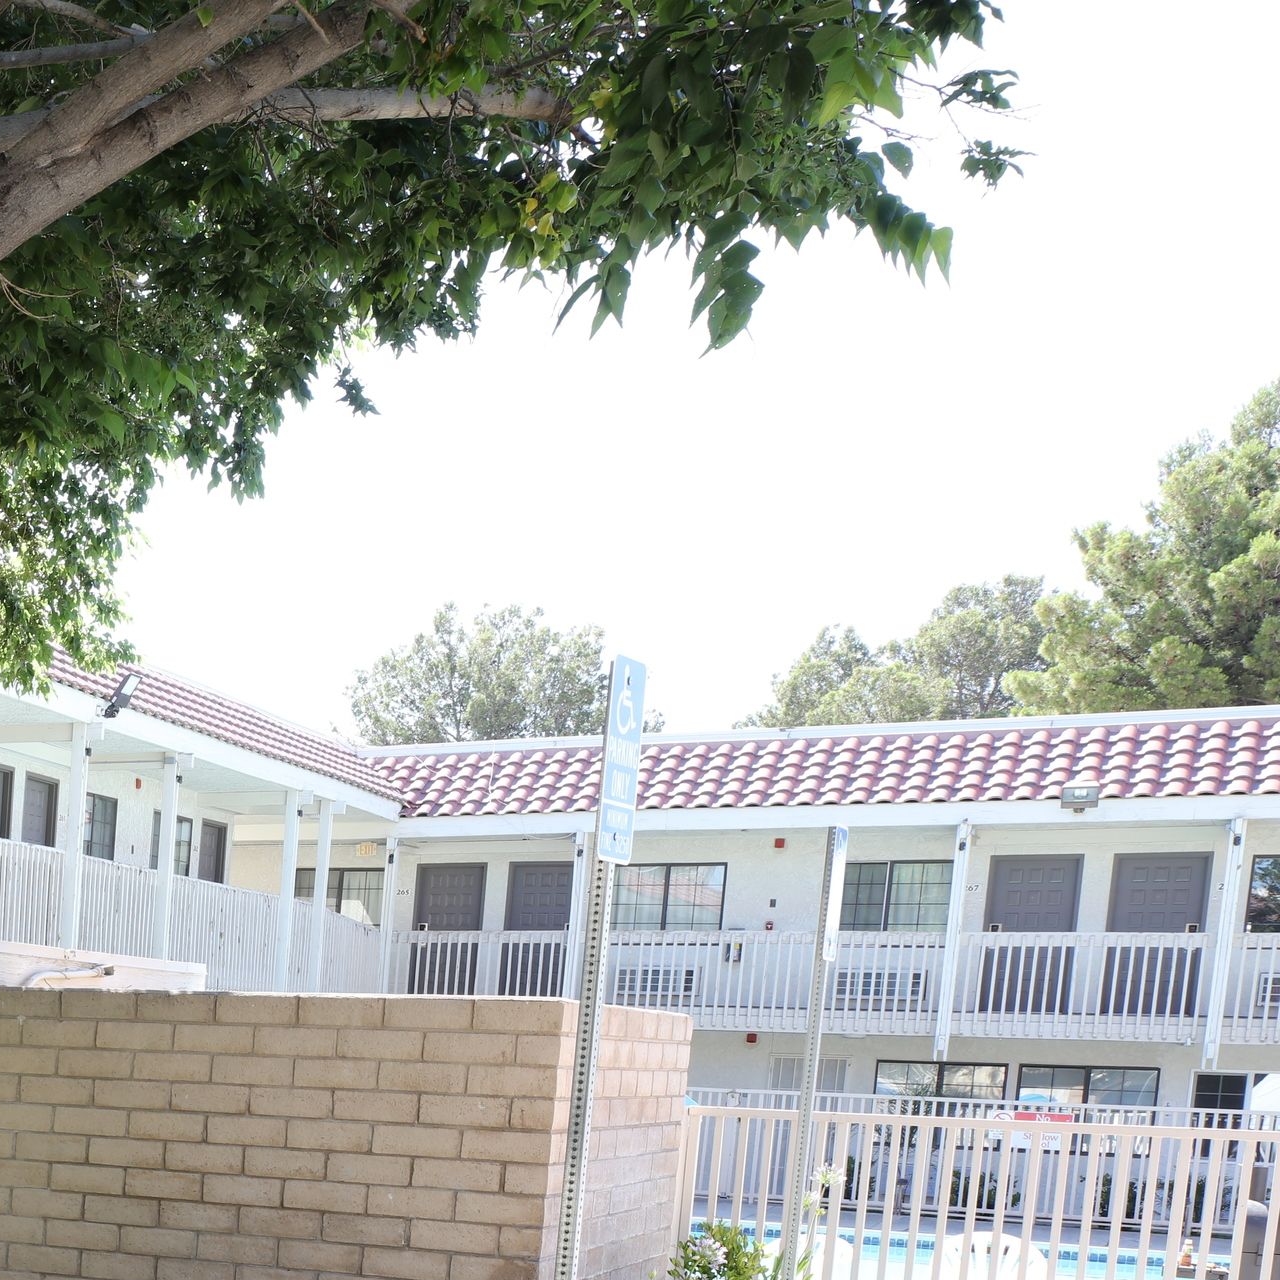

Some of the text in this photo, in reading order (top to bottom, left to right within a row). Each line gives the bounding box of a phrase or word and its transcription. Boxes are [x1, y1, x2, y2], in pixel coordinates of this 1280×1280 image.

[607, 735, 639, 770] PARKING
[611, 769, 630, 800] ONLY
[1036, 1114, 1051, 1122] No
